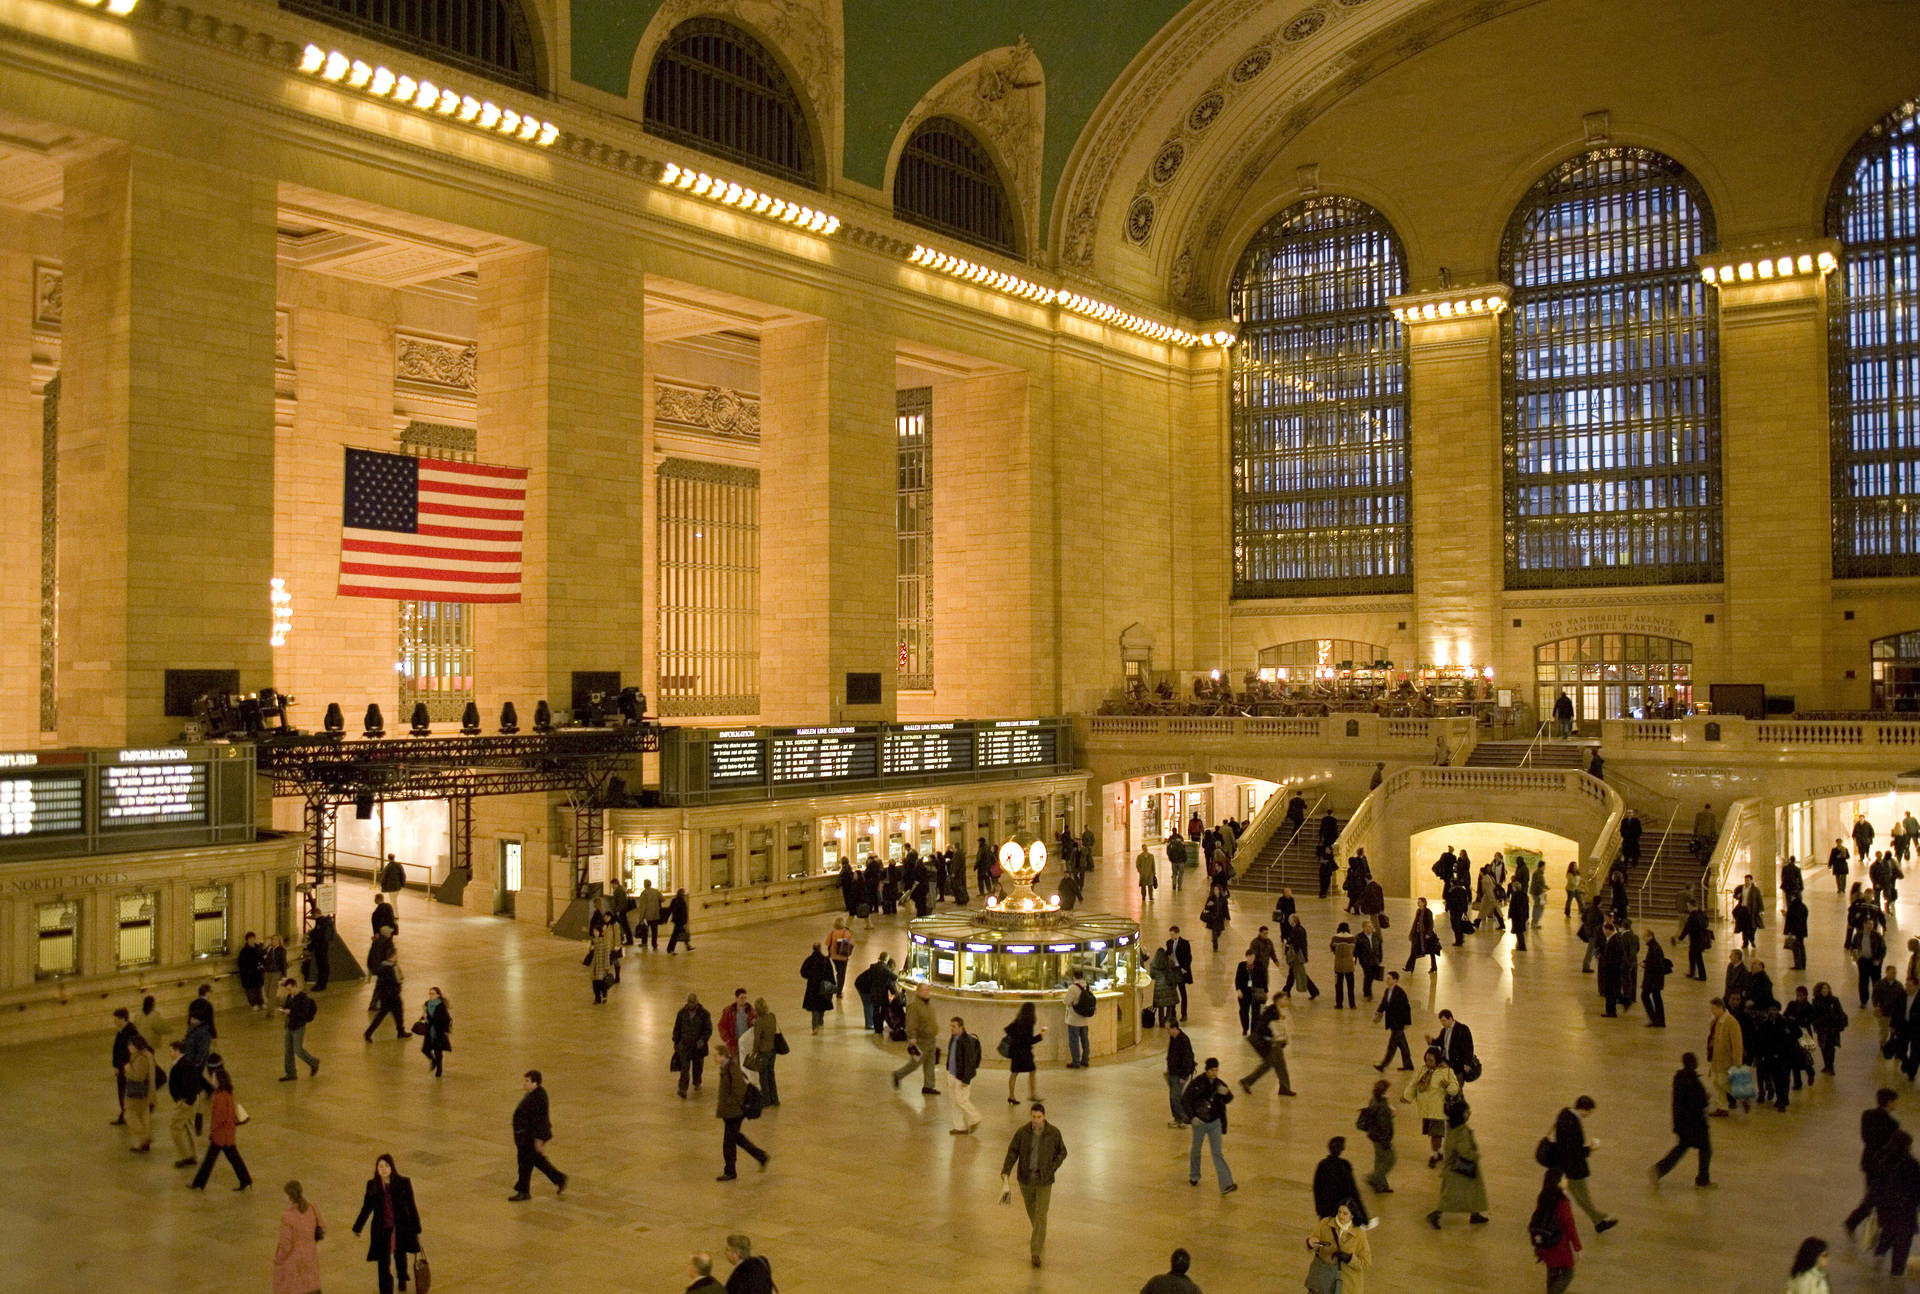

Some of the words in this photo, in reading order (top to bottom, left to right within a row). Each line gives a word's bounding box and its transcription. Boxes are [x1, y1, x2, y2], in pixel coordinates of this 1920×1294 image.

[1549, 620, 1562, 629] TO
[1567, 614, 1628, 624] VANDERBILT
[1635, 615, 1674, 627] AVENUE
[1566, 622, 1617, 634] CAMPBELL
[1622, 623, 1682, 637] APARTMENT
[719, 730, 755, 738] INFORMATION
[817, 727, 828, 735] LINE
[119, 748, 188, 762] INFORMATION
[1120, 763, 1151, 776] SUBWAY
[1152, 762, 1187, 772] SHUTTLE
[1235, 765, 1265, 777] STREET
[1806, 783, 1845, 797] TICKET
[71, 871, 129, 886] TICKETS
